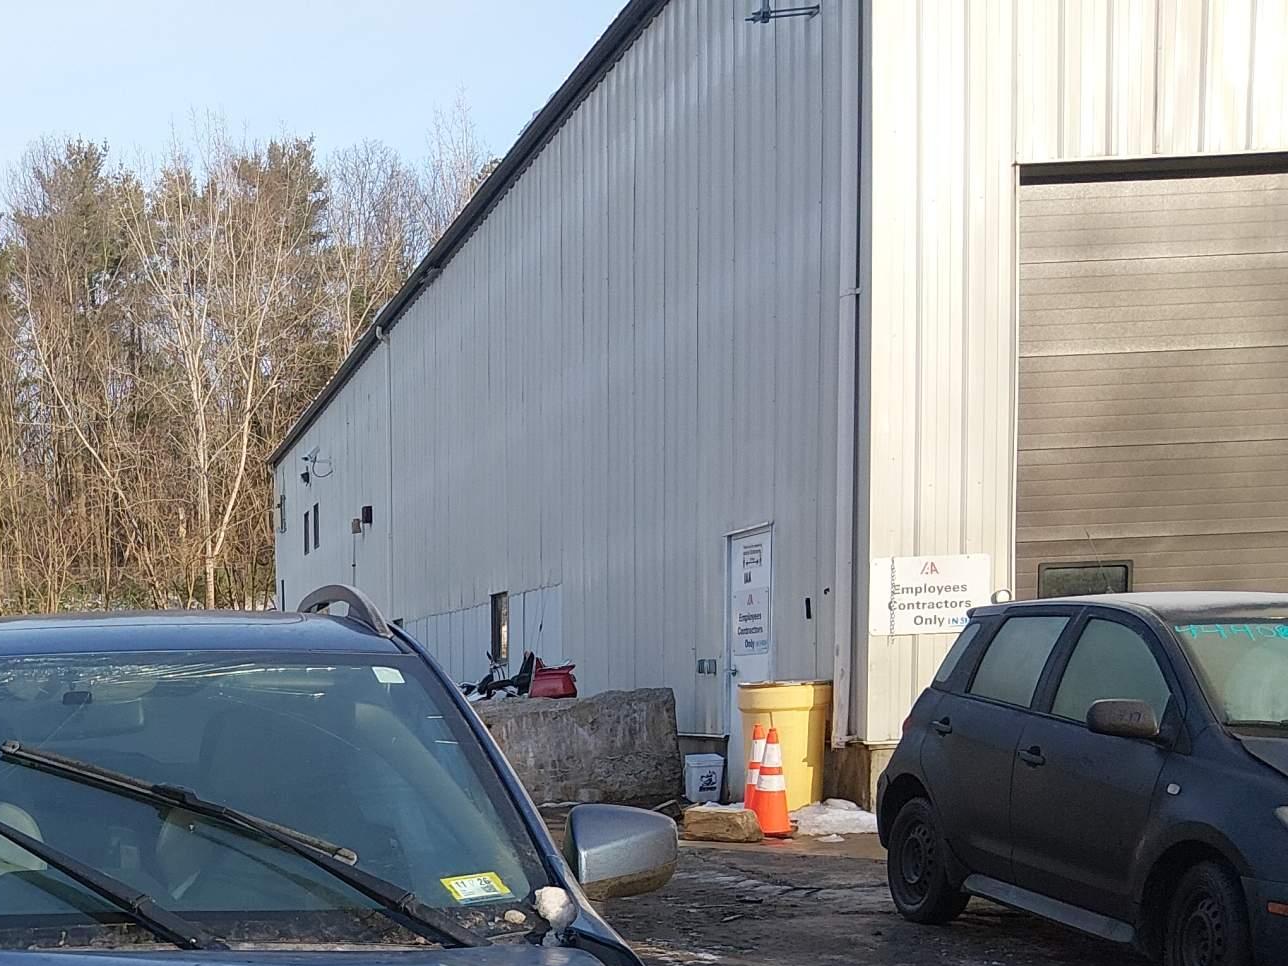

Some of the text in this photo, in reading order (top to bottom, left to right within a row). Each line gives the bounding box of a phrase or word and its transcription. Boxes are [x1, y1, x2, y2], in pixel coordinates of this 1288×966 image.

[892, 584, 968, 596] Employees
[888, 599, 972, 611] Contractors
[739, 612, 762, 622] Employees
[913, 615, 945, 627] Only
[737, 626, 763, 636] Contractors
[744, 639, 755, 649] Only
[454, 880, 468, 888] 11
